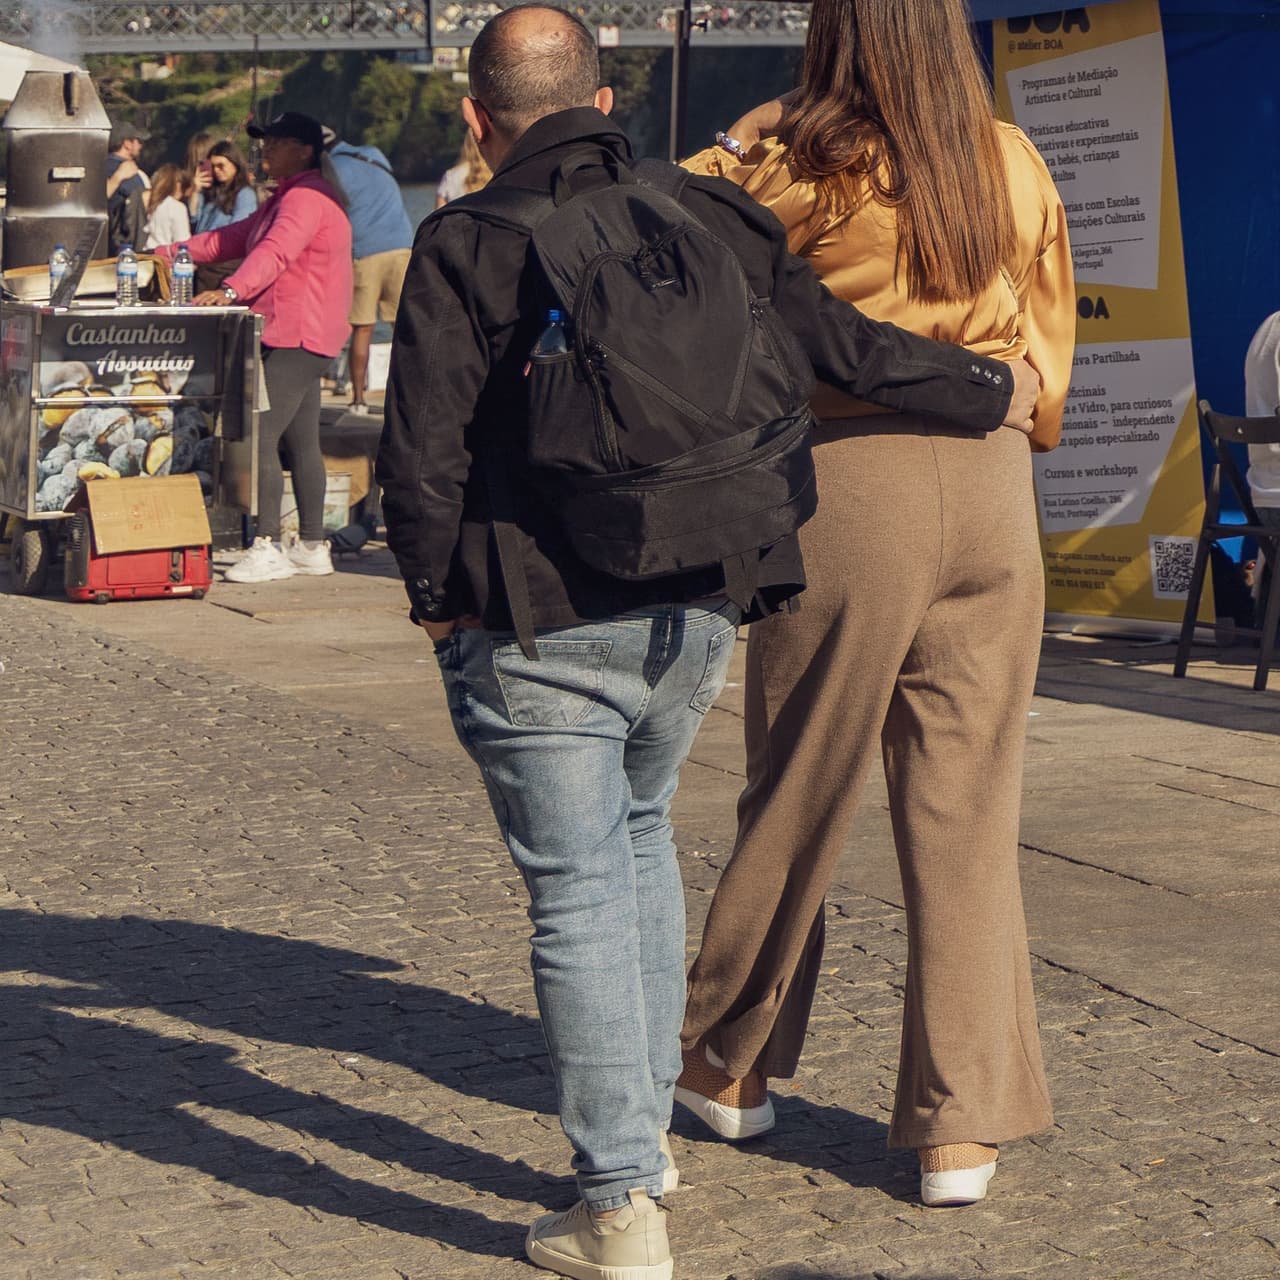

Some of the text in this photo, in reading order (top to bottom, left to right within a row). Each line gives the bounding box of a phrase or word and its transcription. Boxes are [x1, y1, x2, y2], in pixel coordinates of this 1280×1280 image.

[1017, 39, 1041, 49] atelier
[1043, 39, 1063, 49] BOA
[1021, 66, 1118, 90] Programas de Mediação
[1067, 84, 1101, 99] Cultural
[1065, 118, 1109, 131] educativas
[1075, 129, 1139, 148] experimentais
[1083, 149, 1120, 162] crianças
[1051, 170, 1076, 181] dultos
[1064, 195, 1140, 212] erias com Escolas
[1104, 210, 1145, 224] Culturais
[1077, 295, 1110, 319] OA
[65, 322, 187, 346] Castanhas
[95, 349, 196, 376] Assadas
[1073, 349, 1140, 365] tiva Partilhada
[1078, 401, 1108, 414] Vidro,
[1110, 401, 1131, 414] para
[1132, 397, 1172, 409] curiosos
[1112, 413, 1175, 428] independente
[1068, 433, 1093, 447] apoio
[1096, 430, 1159, 446] especializado
[1044, 463, 1137, 479] Cursos e workshops
